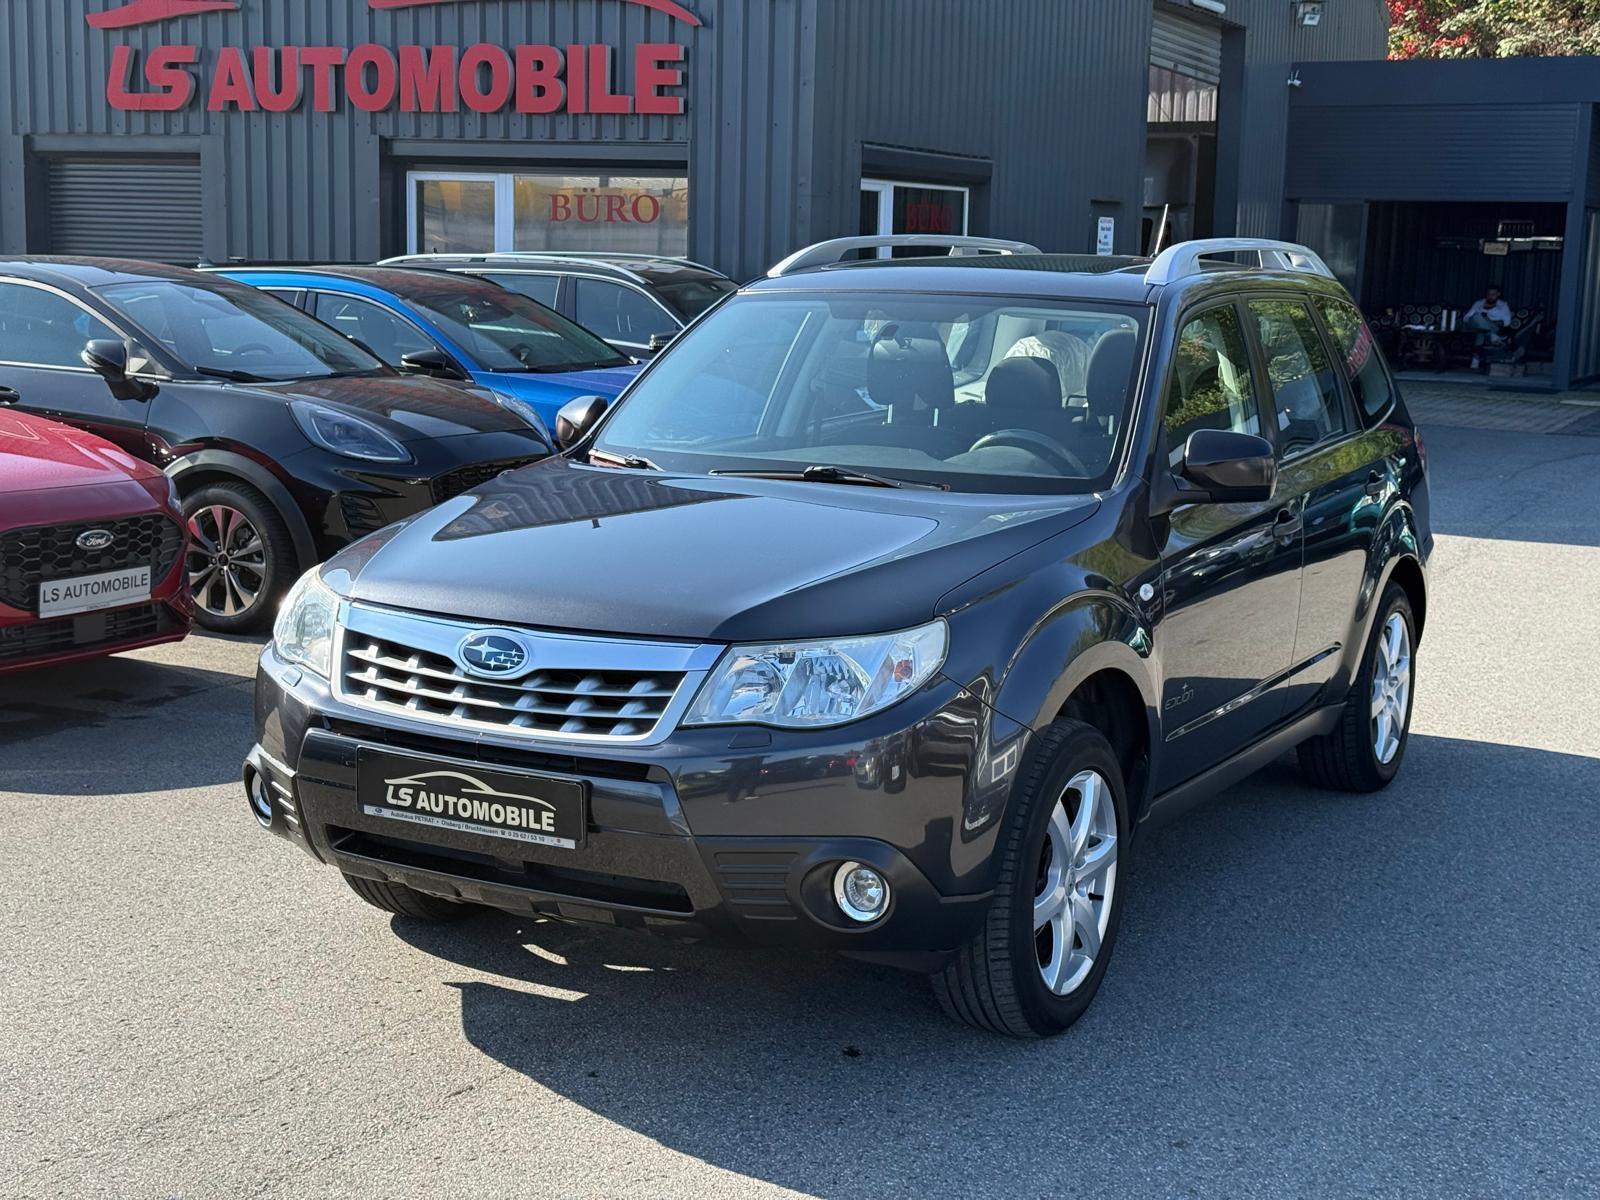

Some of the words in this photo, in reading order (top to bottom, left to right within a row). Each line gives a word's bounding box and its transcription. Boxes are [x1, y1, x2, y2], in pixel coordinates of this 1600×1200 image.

[106, 45, 197, 112] LS
[207, 43, 685, 115] AUTOMOBILE
[549, 187, 661, 225] BÜRO
[43, 587, 60, 604] LS
[63, 573, 149, 600] AUTOMOBILE
[386, 785, 413, 806] LS
[416, 791, 555, 832] AUTOMOBILE
[390, 810, 414, 820] Autohaus
[465, 823, 499, 835] Bruchhausen
